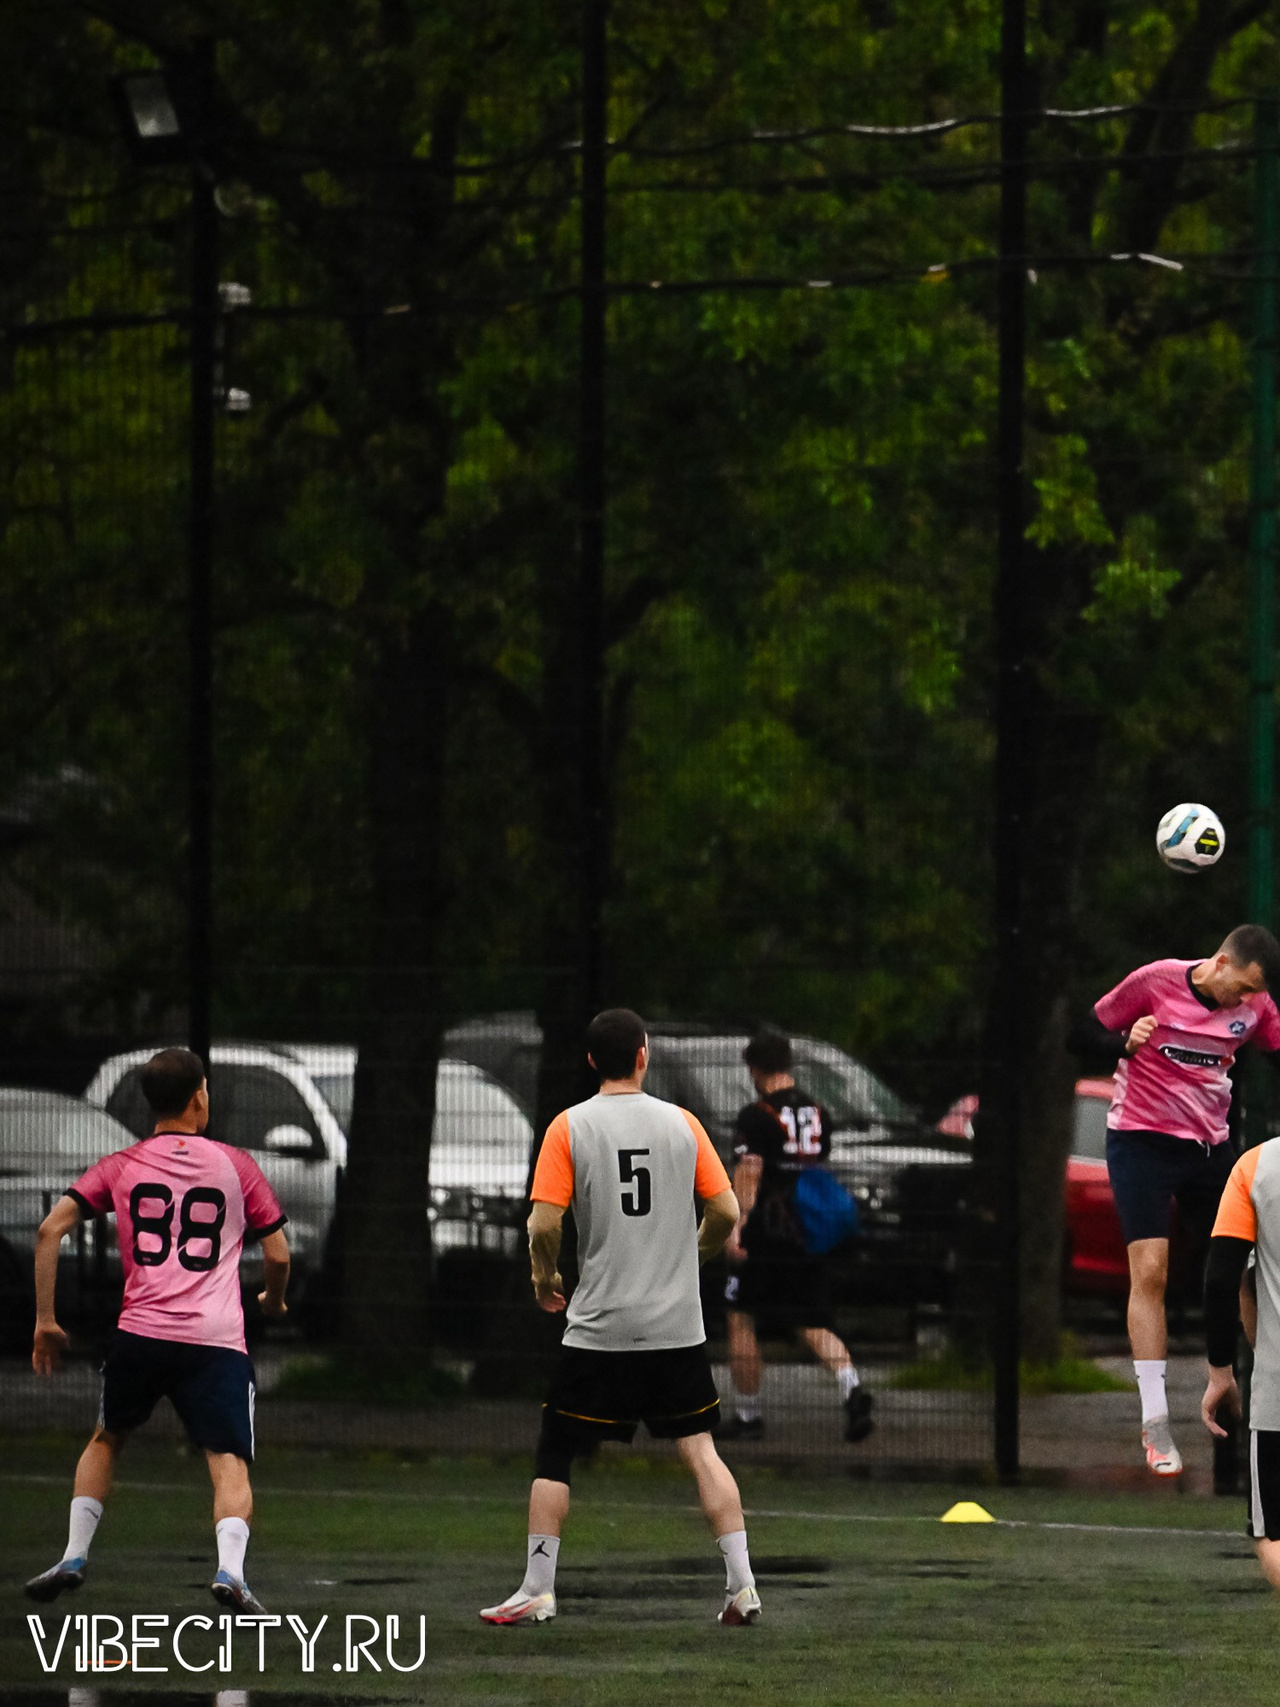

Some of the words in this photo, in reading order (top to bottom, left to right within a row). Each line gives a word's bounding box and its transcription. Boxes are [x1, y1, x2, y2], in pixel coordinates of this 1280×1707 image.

[779, 1105, 822, 1155] 12
[617, 1148, 652, 1218] 5
[129, 1182, 227, 1273] 88
